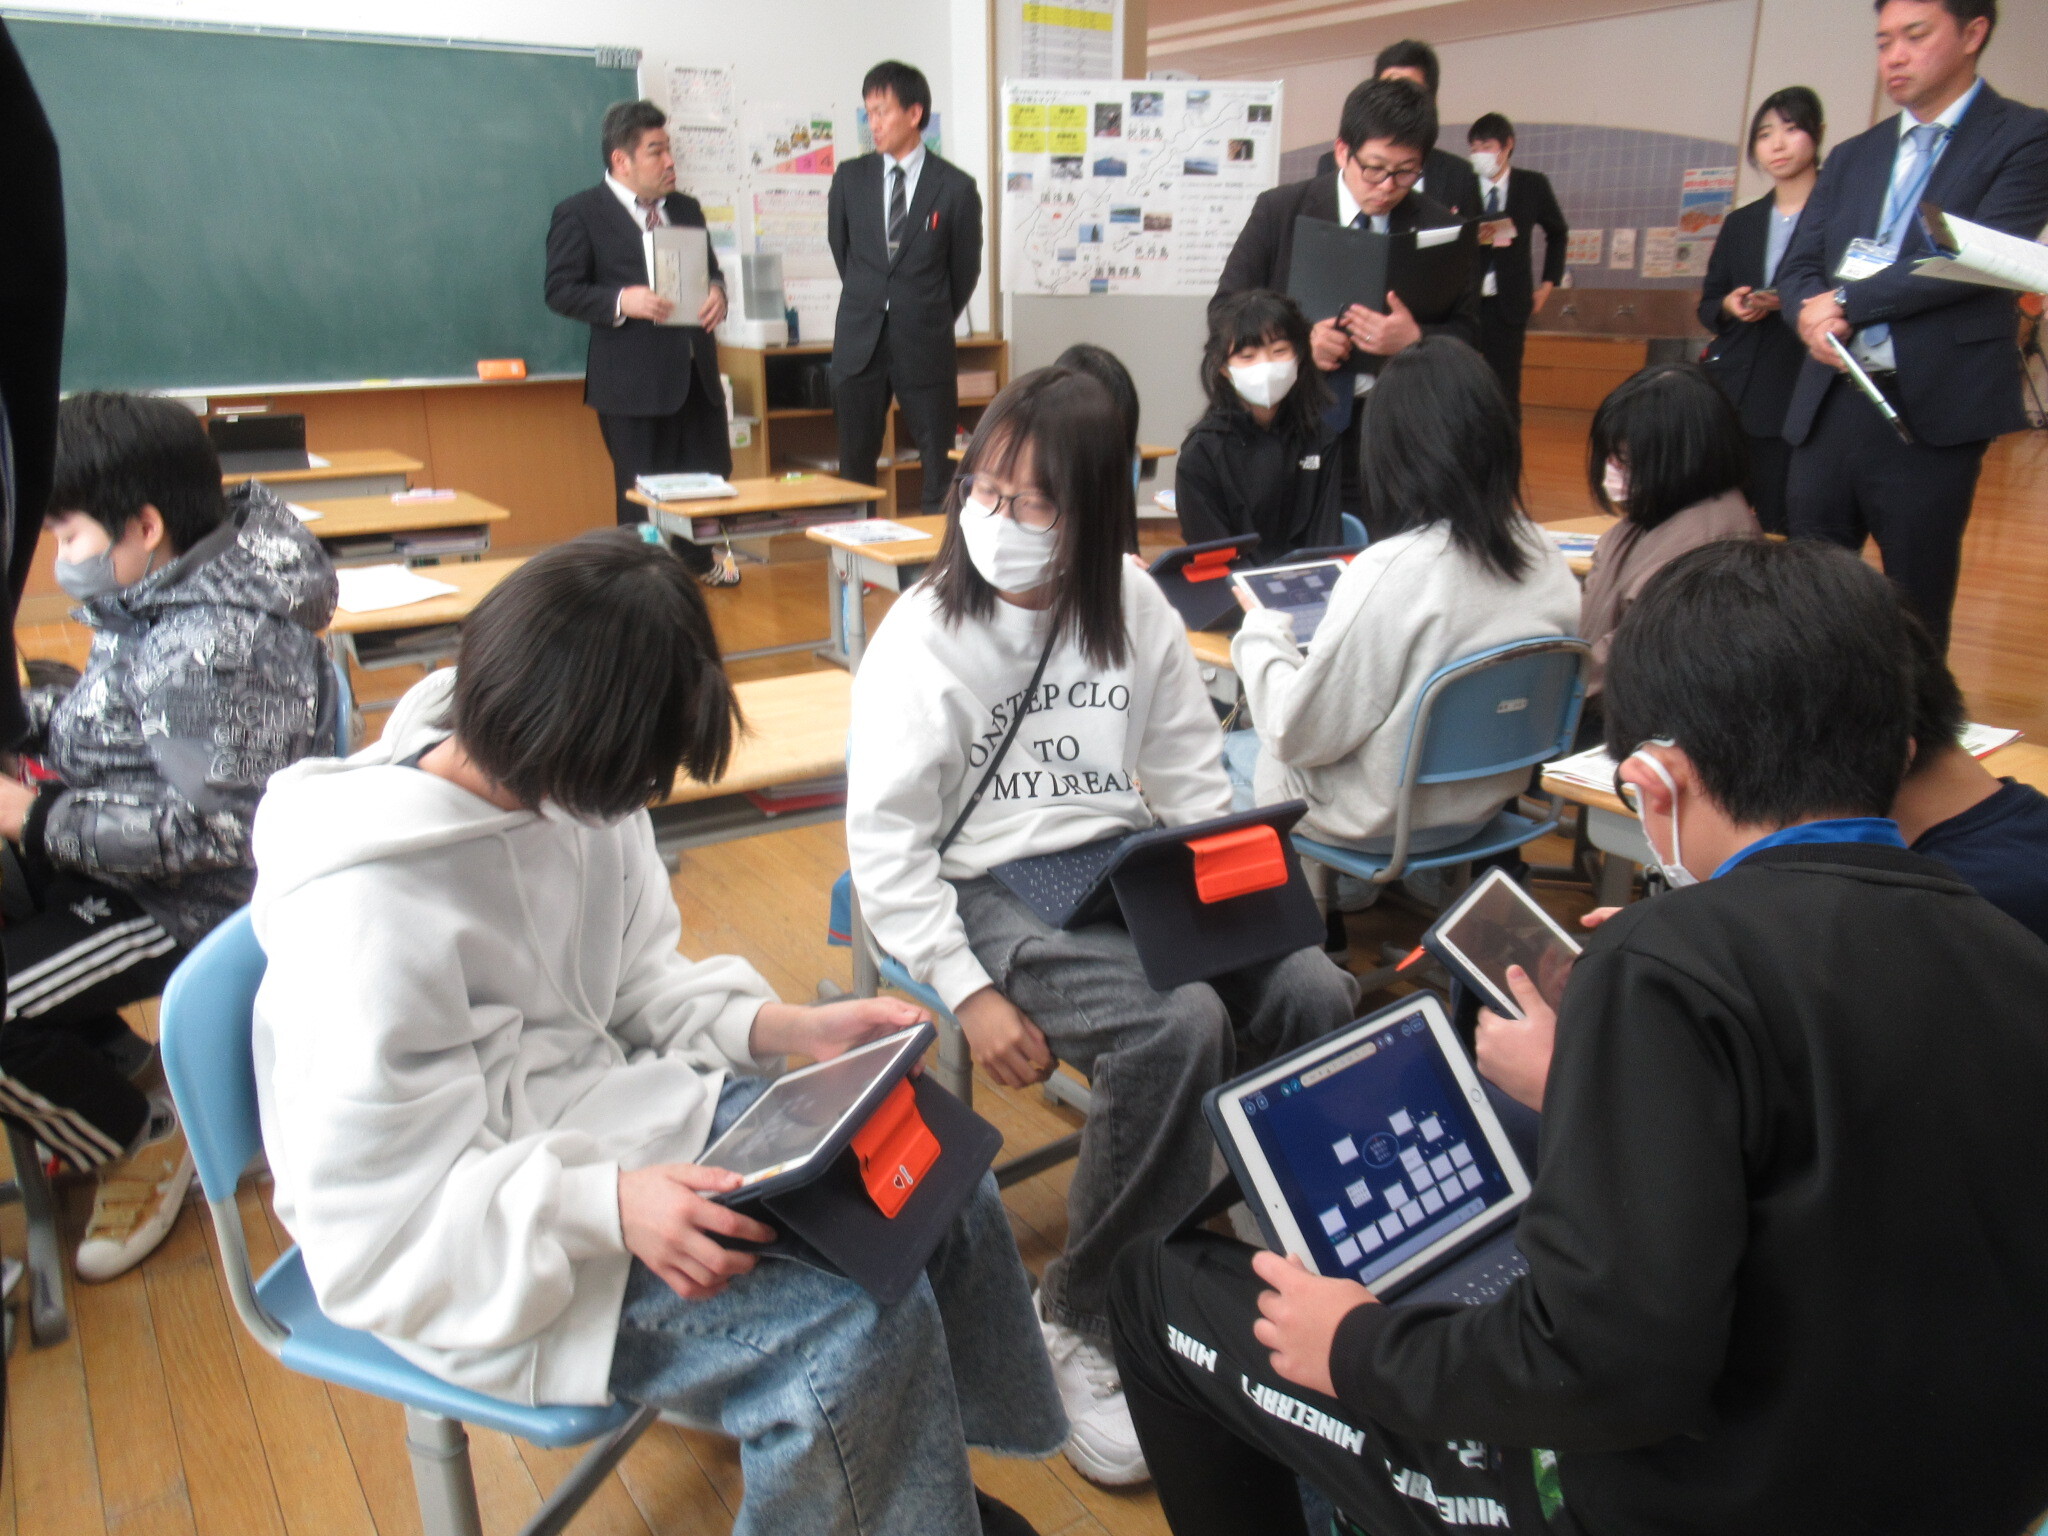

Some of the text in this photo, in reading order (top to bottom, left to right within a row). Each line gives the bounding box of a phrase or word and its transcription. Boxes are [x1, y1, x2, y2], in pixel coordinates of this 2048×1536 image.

[1068, 681, 1130, 712] CLO
[1033, 735, 1080, 763] TO
[993, 771, 1042, 801] MY
